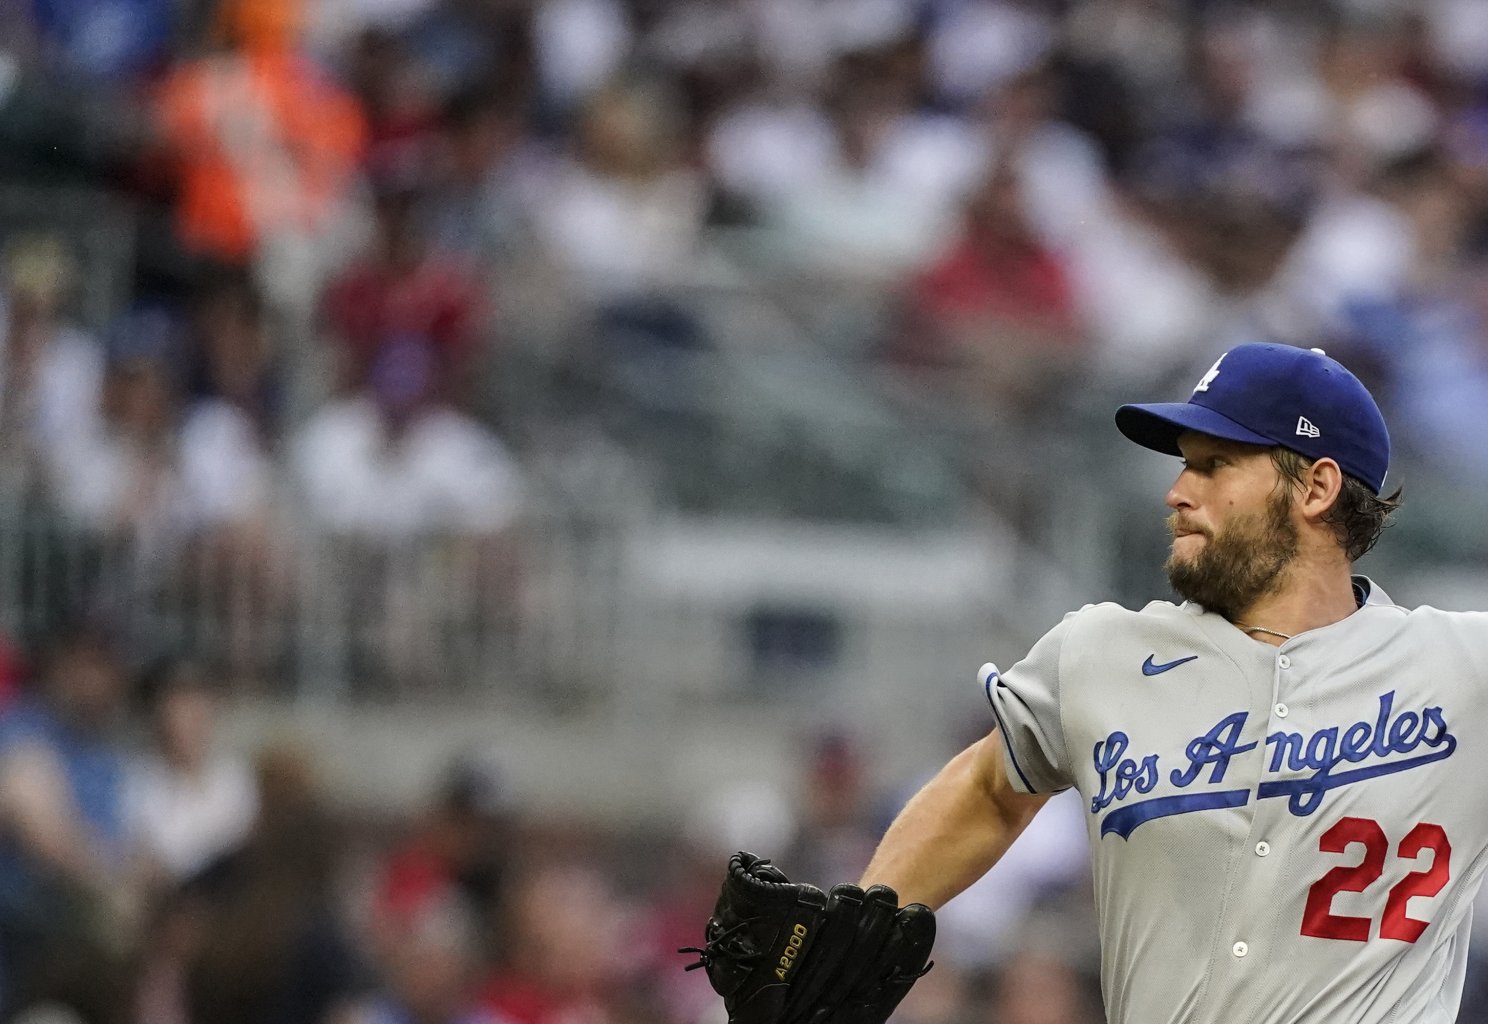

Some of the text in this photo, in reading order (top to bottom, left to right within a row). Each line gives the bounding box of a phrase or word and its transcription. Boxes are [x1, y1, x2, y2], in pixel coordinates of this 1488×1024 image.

[1091, 731, 1159, 813] Los
[1300, 817, 1451, 943] 22
[775, 923, 808, 981] A2000
